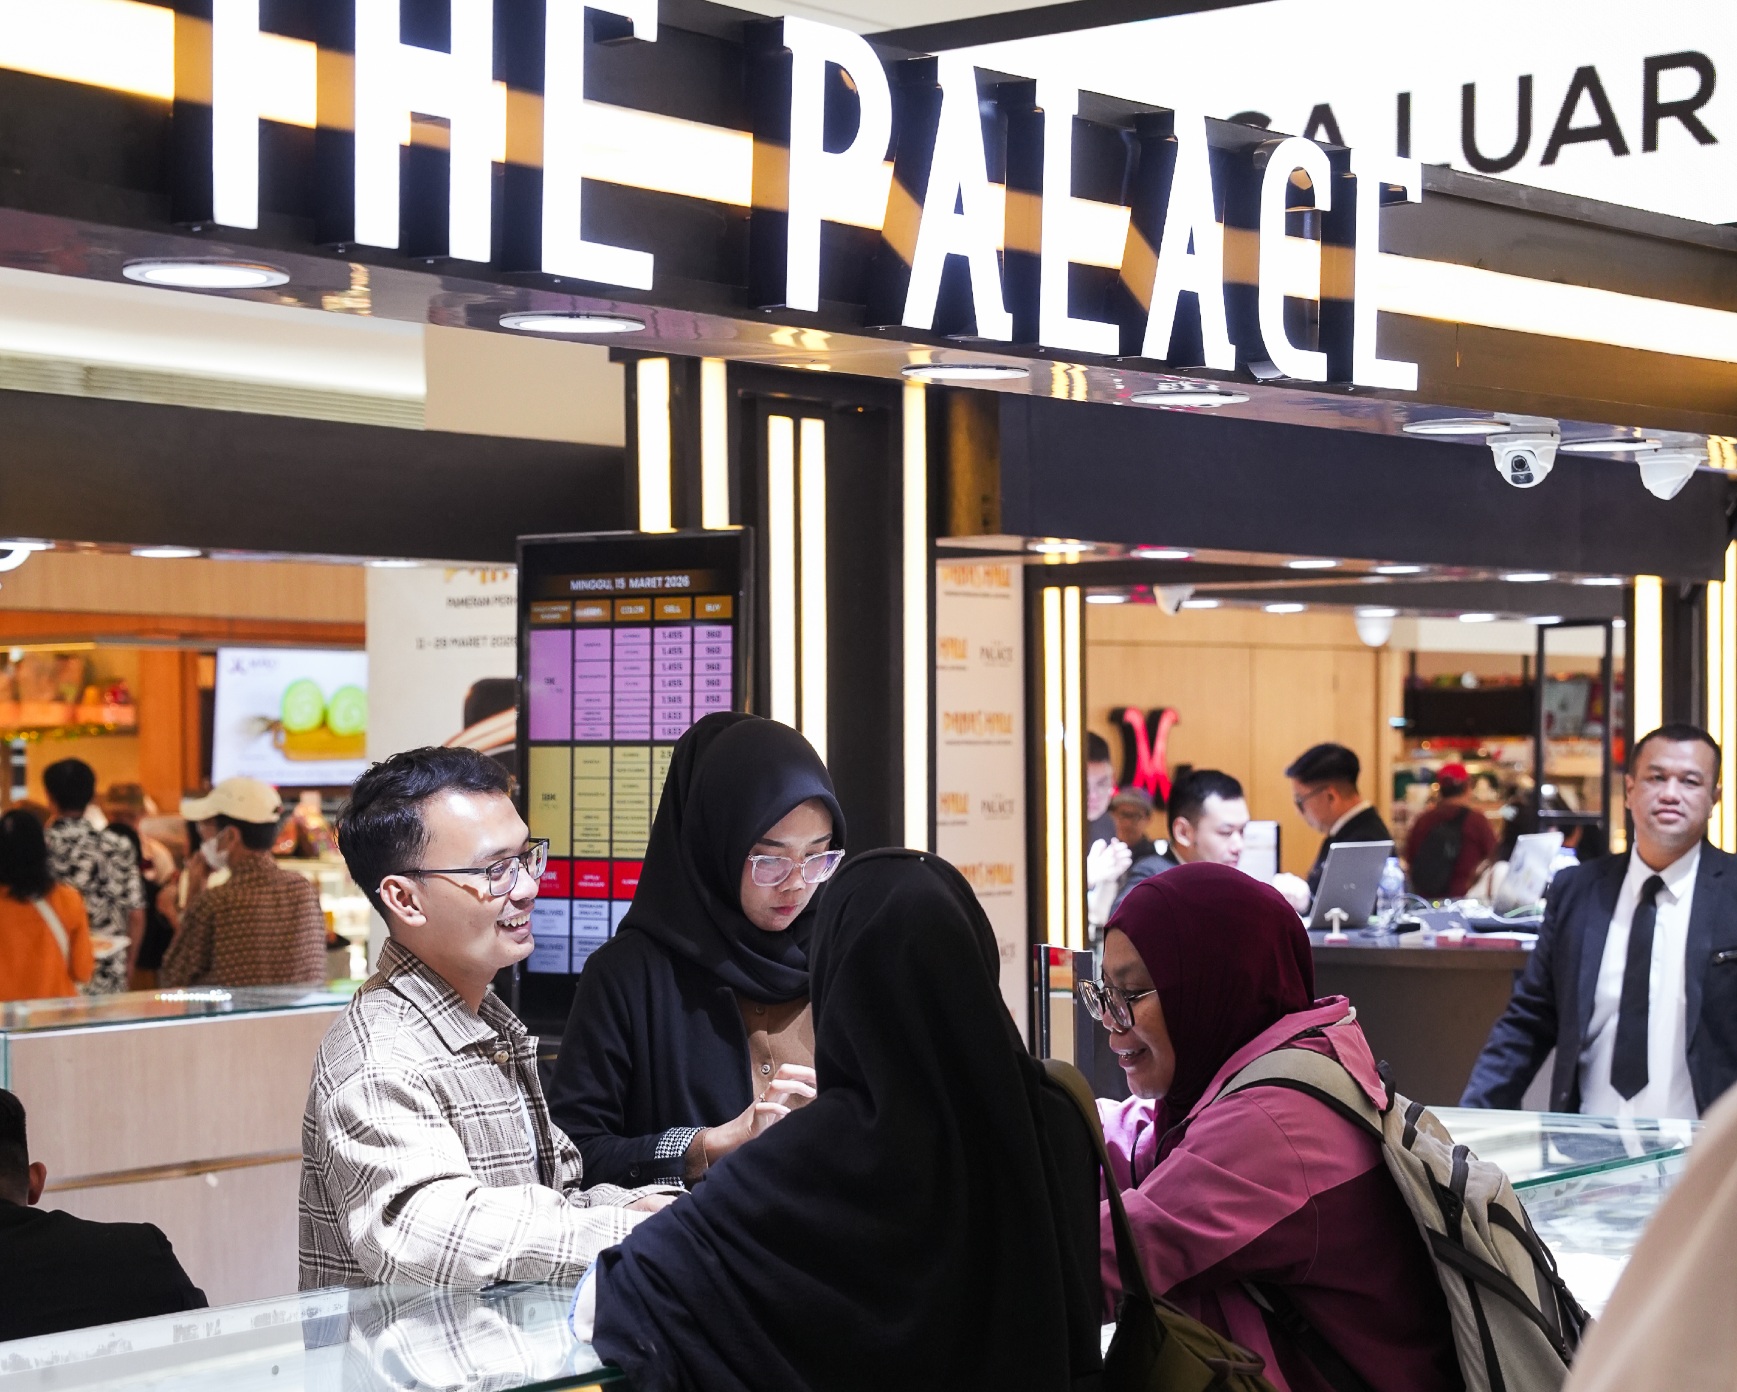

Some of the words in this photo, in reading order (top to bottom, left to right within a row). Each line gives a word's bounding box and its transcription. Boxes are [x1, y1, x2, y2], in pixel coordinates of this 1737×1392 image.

[782, 14, 1423, 391] PALACE
[629, 576, 663, 588] MARET
[664, 574, 690, 588] 2026
